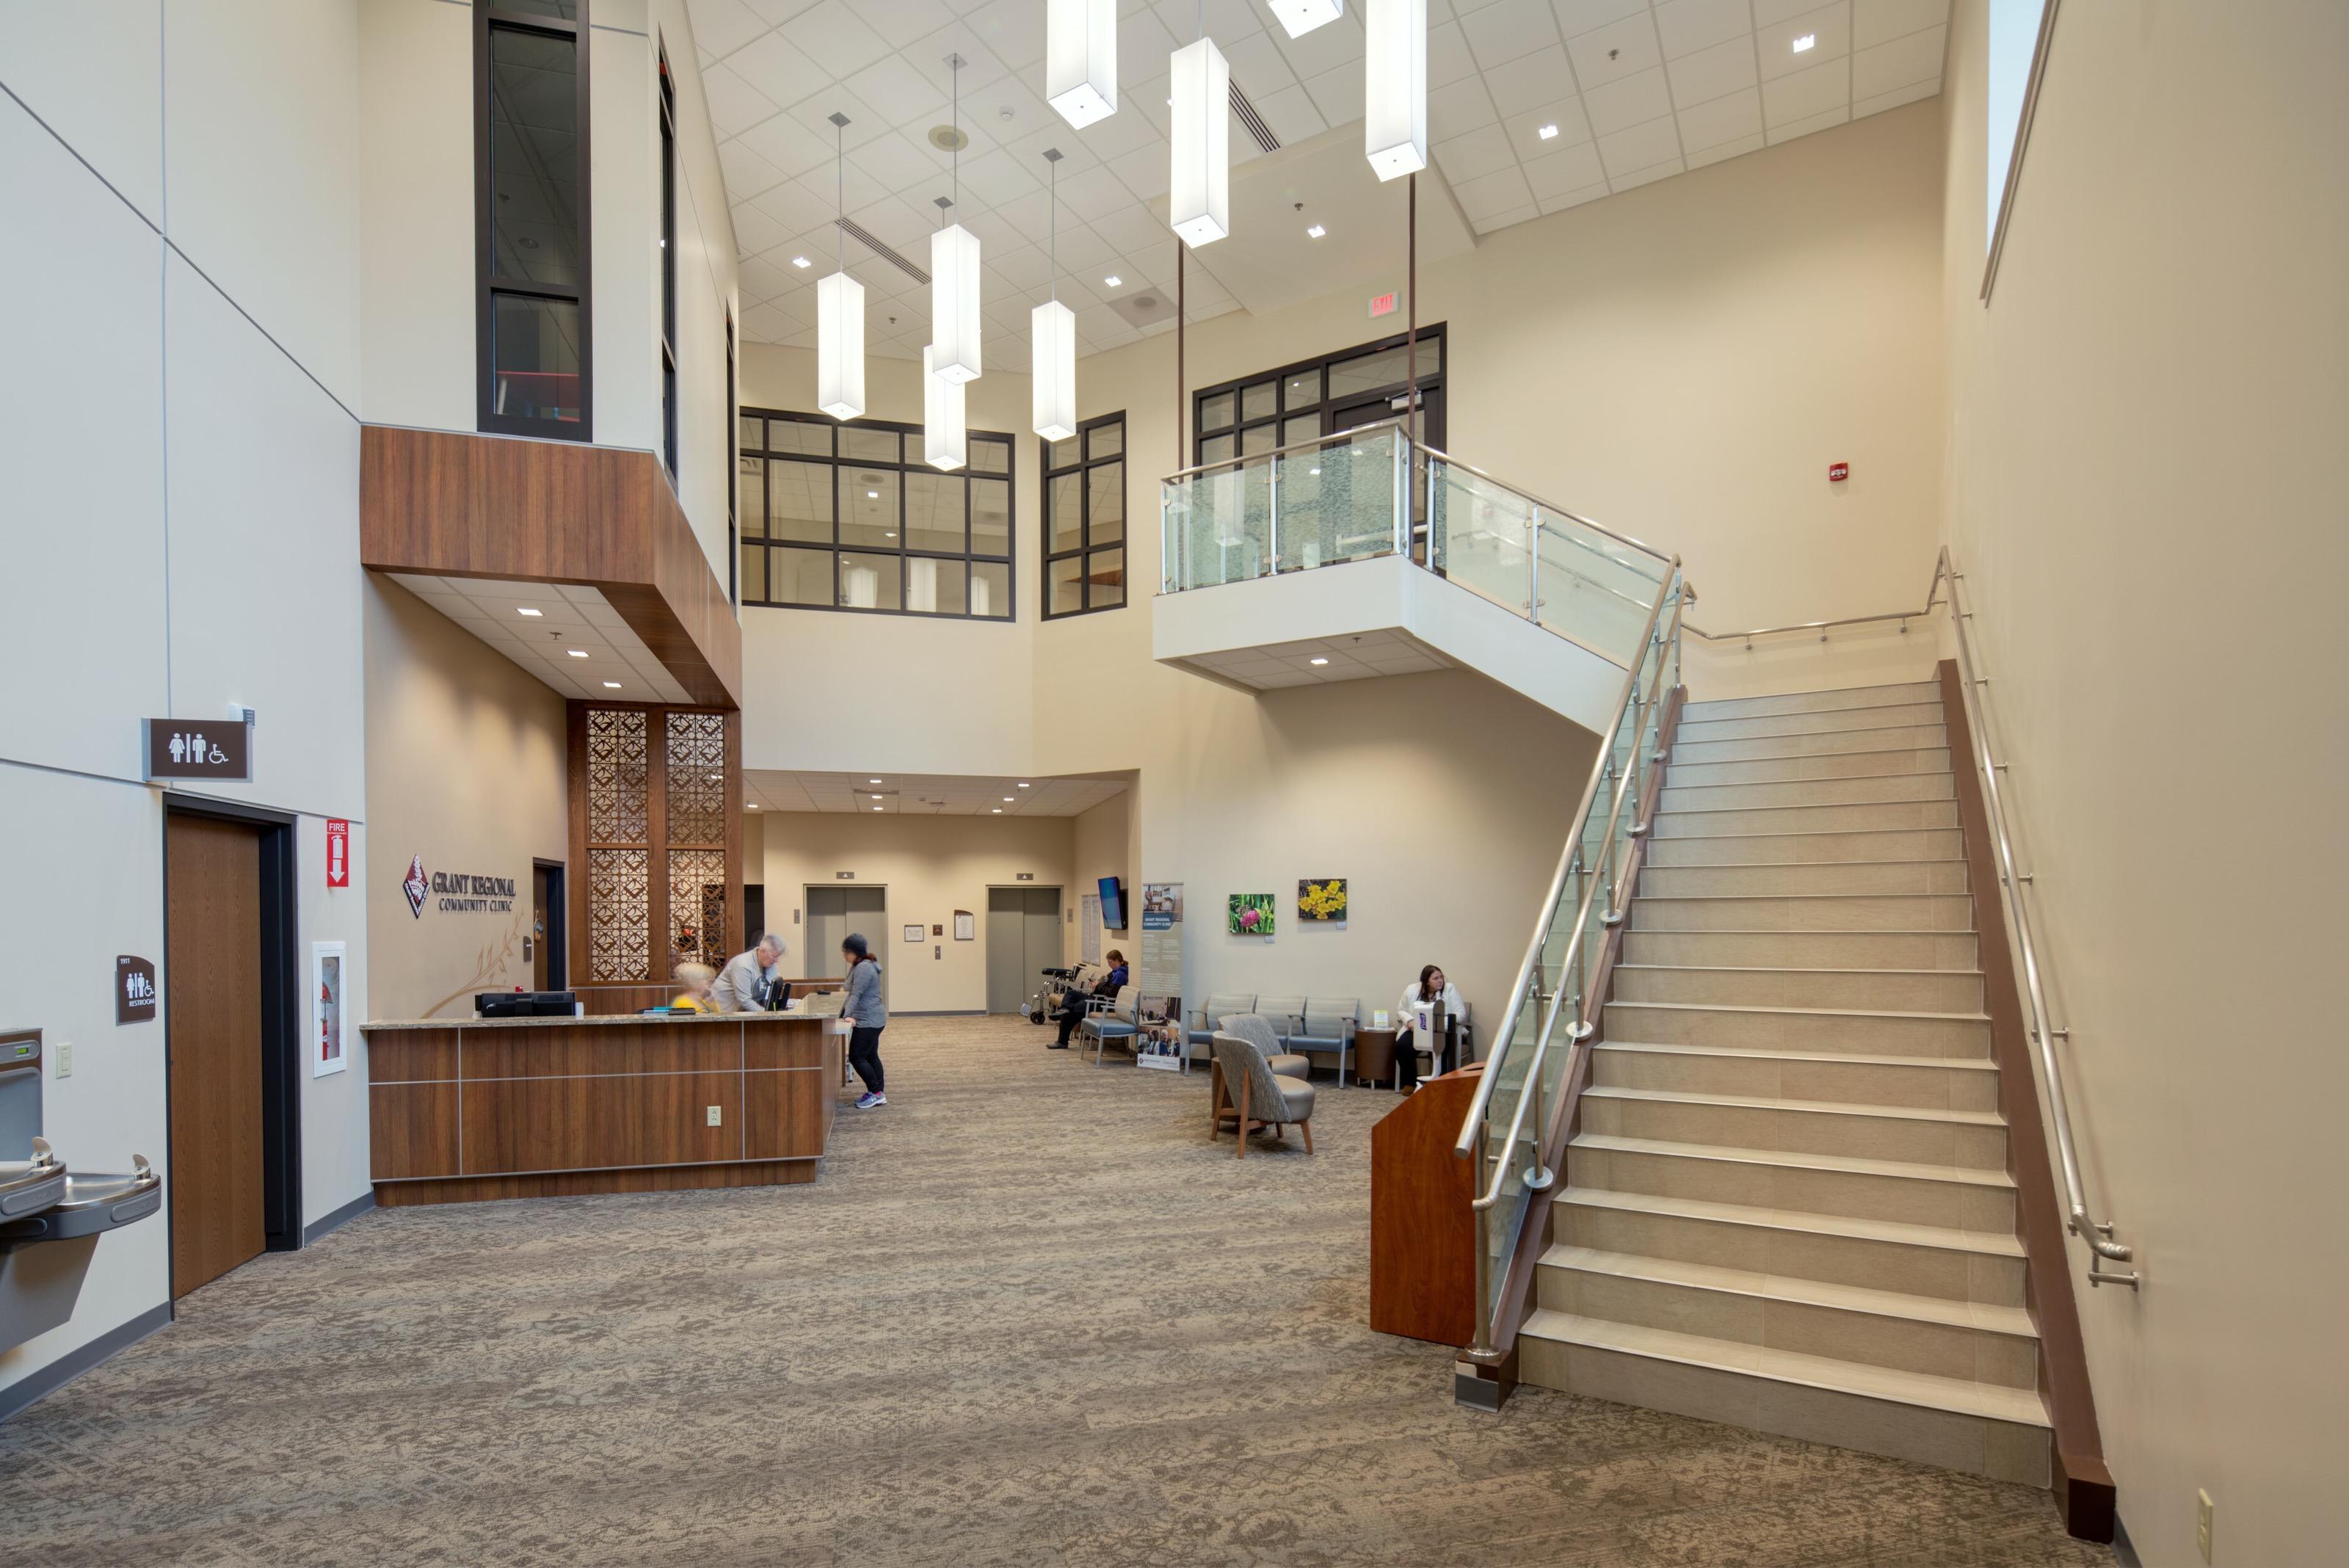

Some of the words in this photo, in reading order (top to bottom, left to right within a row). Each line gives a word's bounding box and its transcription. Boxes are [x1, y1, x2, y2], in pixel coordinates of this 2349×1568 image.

[1374, 294, 1393, 315] EXIT
[329, 823, 345, 832] FIRE
[432, 871, 469, 894] GRANT
[471, 875, 516, 896] REGIONAL
[439, 898, 487, 911] COMMUNITY
[490, 900, 512, 912] CLINIC
[129, 998, 155, 1007] RESTROOM
